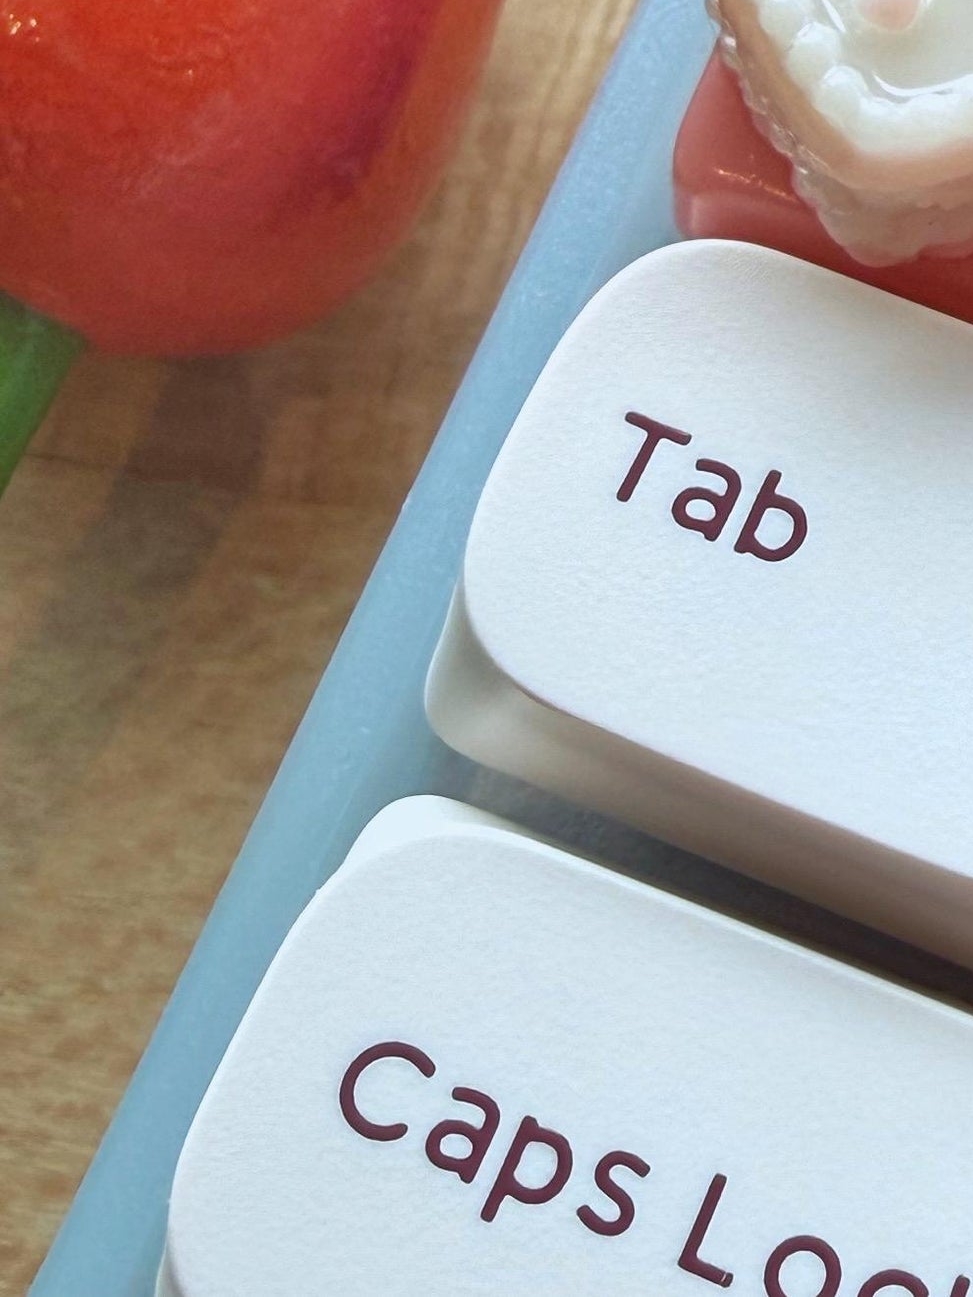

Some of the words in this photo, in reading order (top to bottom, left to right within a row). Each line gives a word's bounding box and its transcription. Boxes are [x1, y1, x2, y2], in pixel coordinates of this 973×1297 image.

[615, 410, 809, 564] Tab
[337, 1040, 652, 1238] Caps
[676, 1172, 972, 1297] Lo
